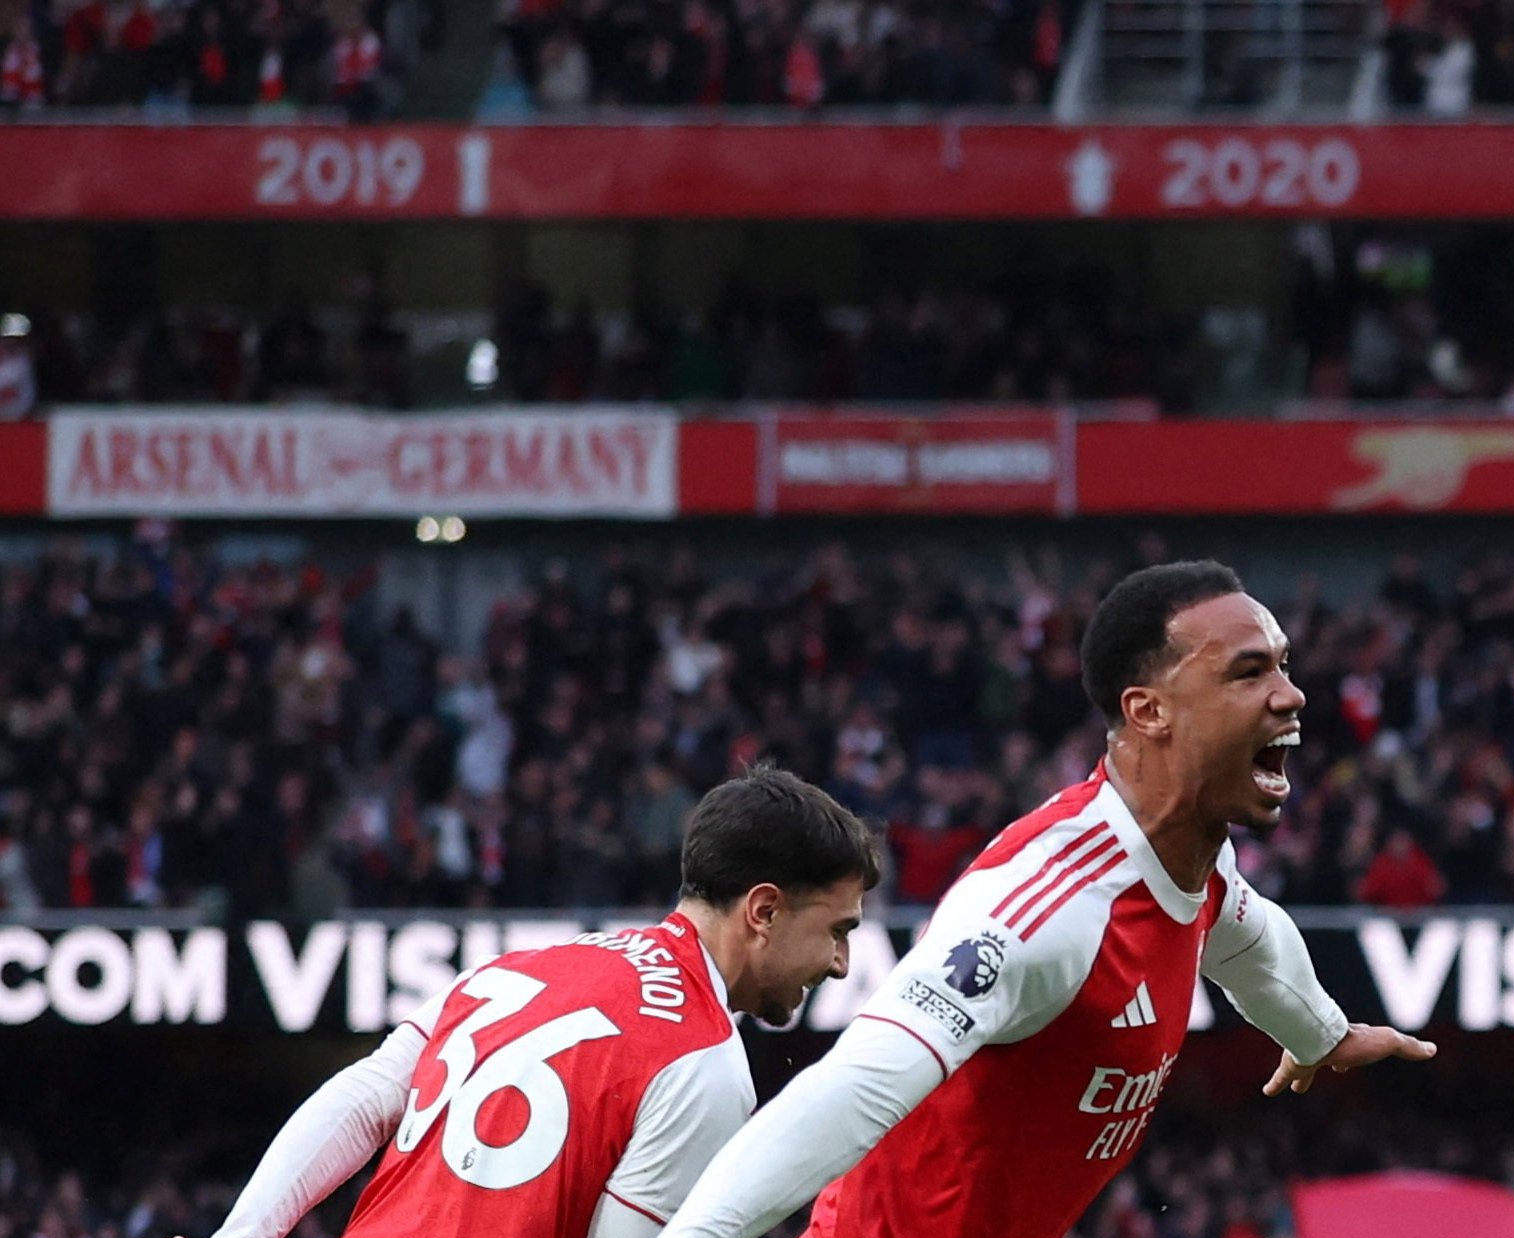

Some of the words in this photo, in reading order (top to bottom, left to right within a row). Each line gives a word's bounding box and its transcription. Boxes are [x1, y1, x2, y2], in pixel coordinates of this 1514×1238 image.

[256, 136, 426, 207] 2019
[1161, 138, 1362, 207] 2020
[70, 427, 303, 497] ARSENAL
[388, 428, 660, 497] GERMANY
[902, 978, 932, 998] No
[927, 992, 969, 1028] room
[397, 966, 622, 1190] 36
[1085, 1117, 1138, 1161] FLY
